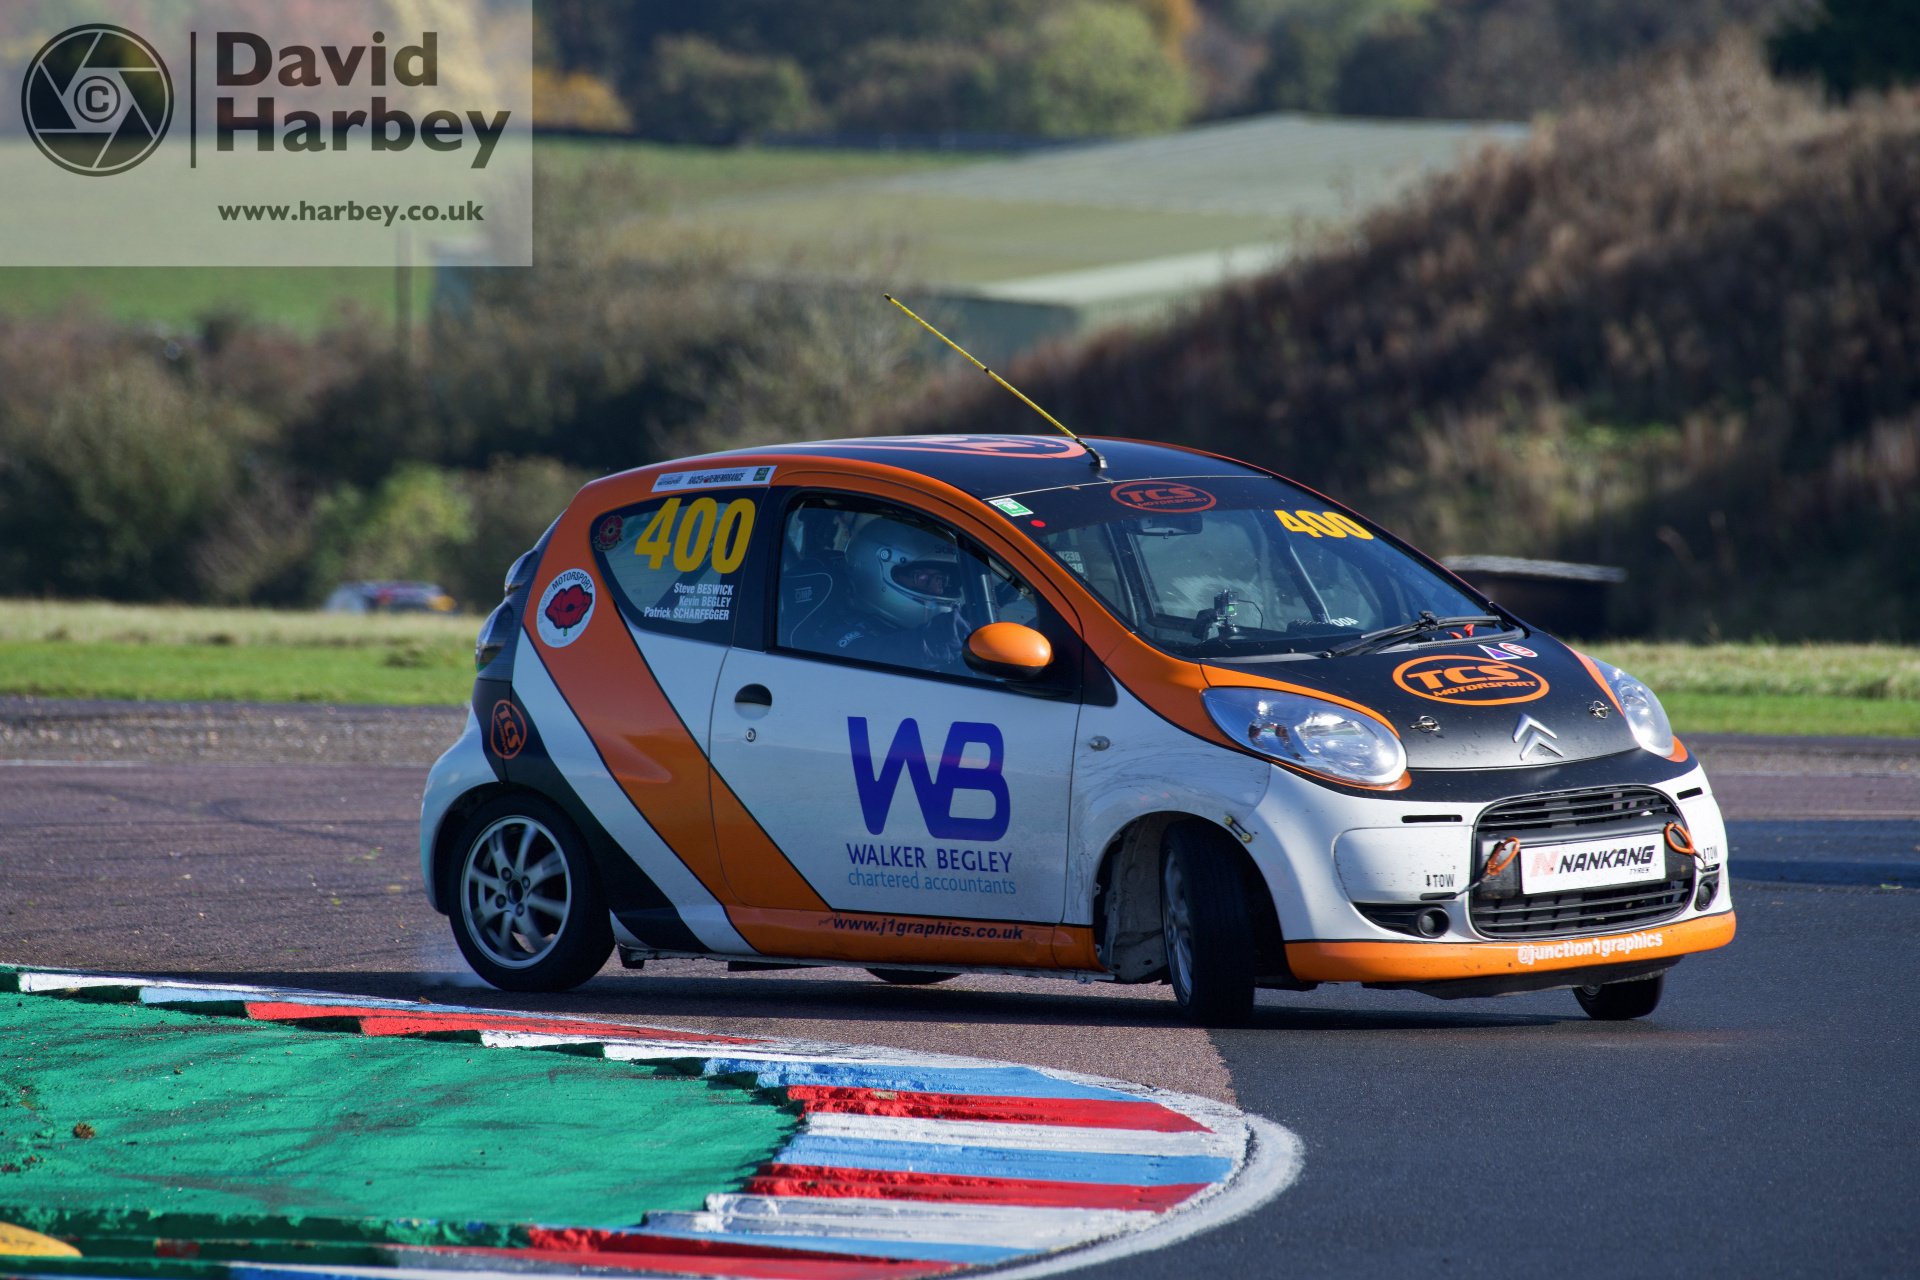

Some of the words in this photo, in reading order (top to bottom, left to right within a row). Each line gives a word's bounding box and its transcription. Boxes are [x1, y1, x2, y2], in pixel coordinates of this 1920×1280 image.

[1119, 487, 1197, 502] TCS
[1137, 497, 1208, 507] MOTORSPORT
[634, 497, 755, 574] 400
[1273, 509, 1374, 540] 400
[551, 571, 593, 591] MOTORSPORT
[674, 582, 695, 594] Steve
[697, 584, 734, 596] BESWICK
[644, 606, 671, 618] Patrick
[673, 607, 730, 620] SCHARFEGGER
[678, 595, 700, 607] Kevin
[701, 596, 732, 608] BEGLEY
[1406, 665, 1520, 690] TCS
[1432, 680, 1537, 697] MOTORSPORT
[847, 716, 1011, 842] WB
[846, 843, 927, 869] WALKER
[937, 848, 1013, 873] BEGLEY
[1558, 845, 1656, 874] NANKANG
[848, 868, 920, 889] chartered
[925, 875, 1017, 895] accountants
[1433, 874, 1455, 888] TOW
[833, 915, 1024, 940] www.j1graphics.co.uk
[1518, 932, 1663, 965] @junction1graphics
